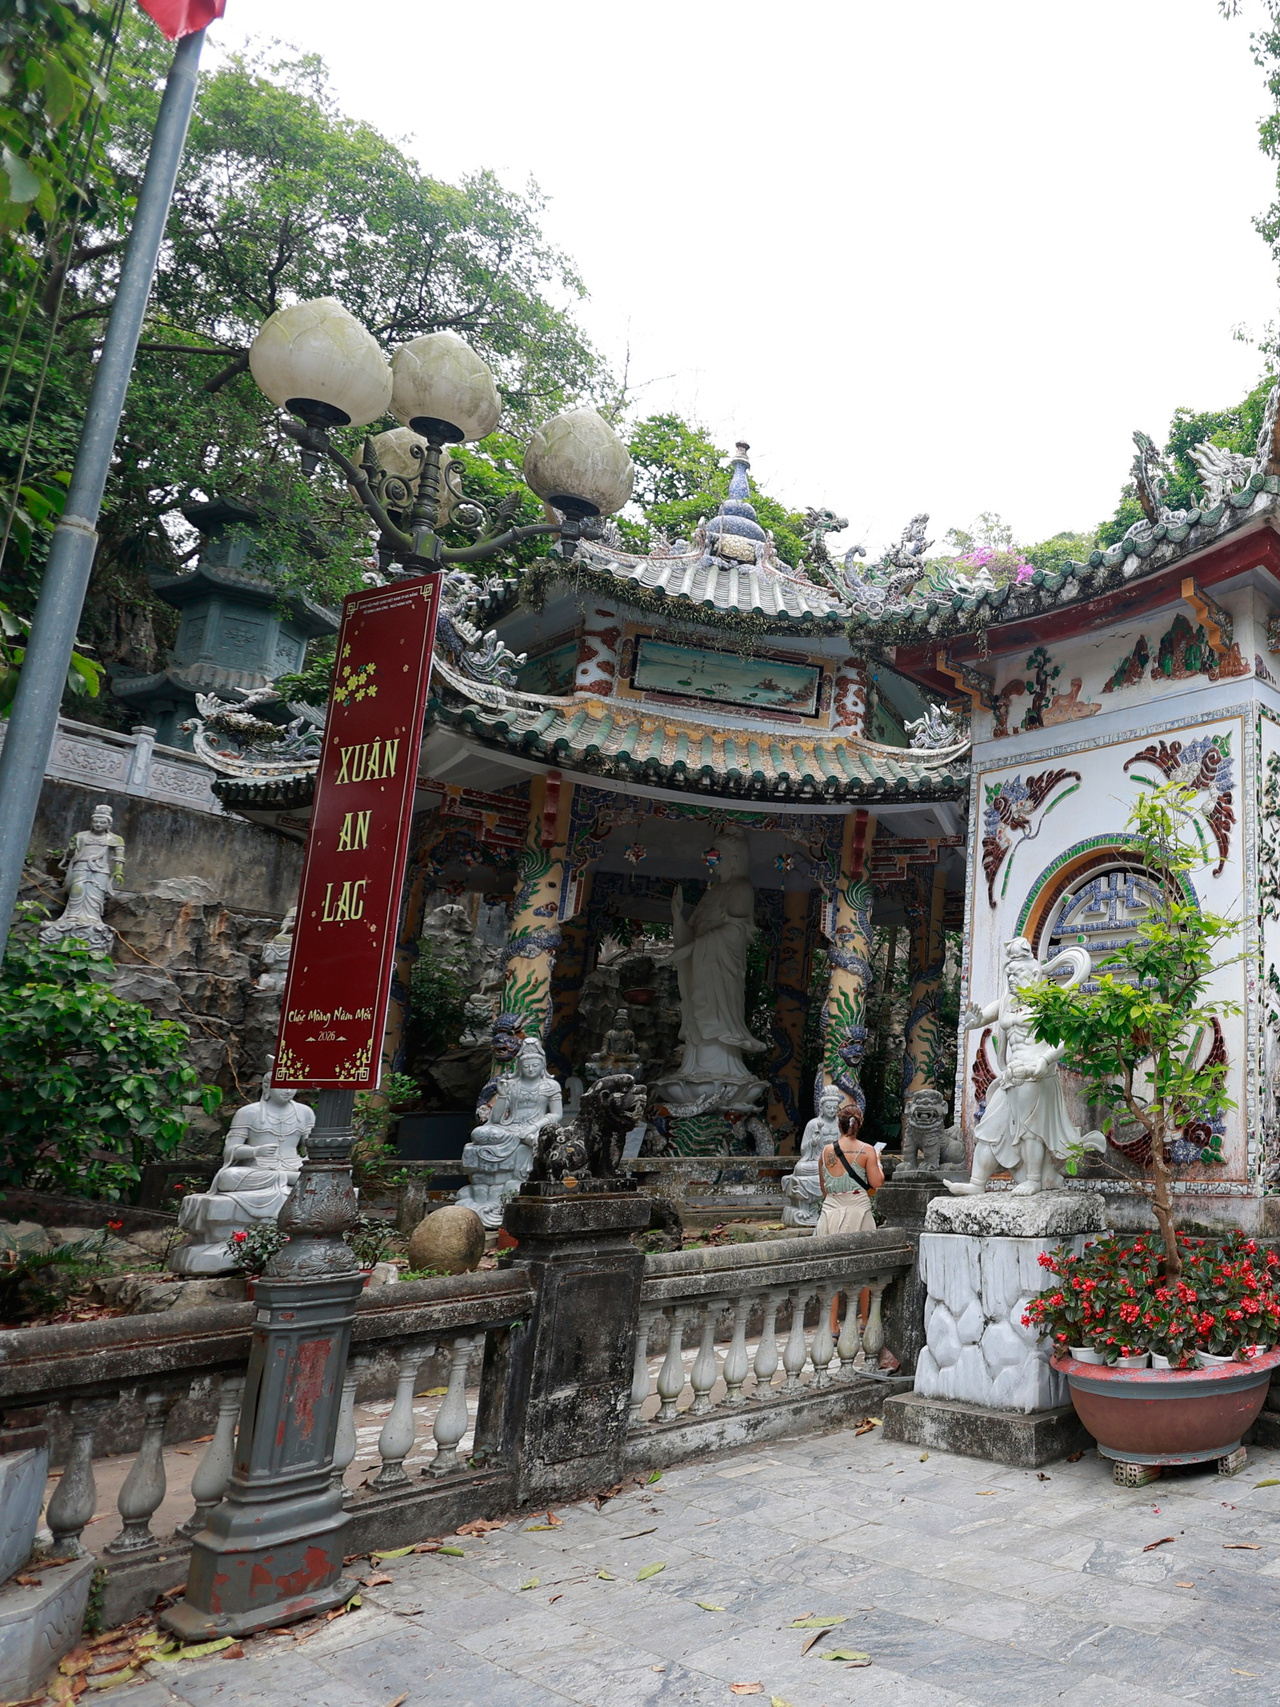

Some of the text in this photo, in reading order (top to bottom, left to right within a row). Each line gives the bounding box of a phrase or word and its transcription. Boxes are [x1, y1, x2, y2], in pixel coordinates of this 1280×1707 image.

[335, 736, 400, 785] XUÂN
[336, 810, 372, 852] AN
[288, 1006, 373, 1028] Chúc Mừng Năm Mới
[317, 1031, 336, 1042] 2026
